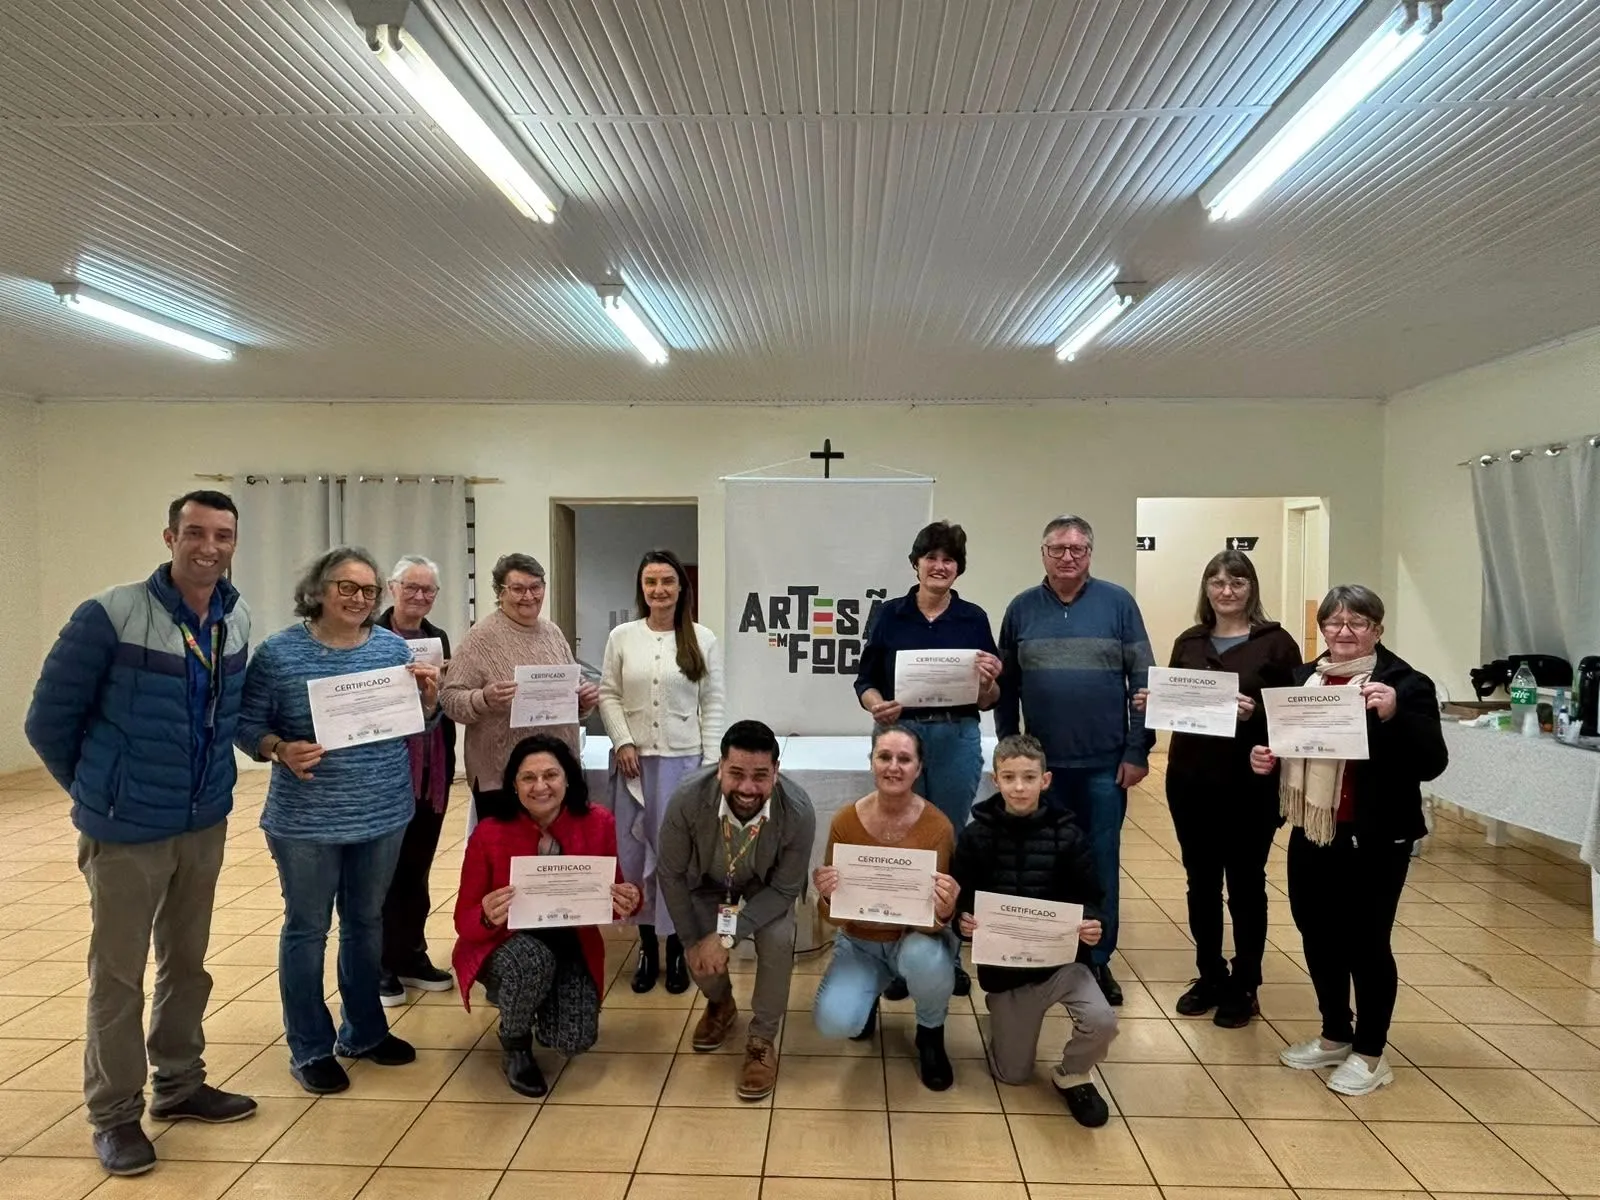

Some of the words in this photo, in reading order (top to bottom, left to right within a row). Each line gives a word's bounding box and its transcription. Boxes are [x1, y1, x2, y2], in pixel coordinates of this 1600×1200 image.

[738, 585, 887, 640] ARTESÃ
[788, 633, 862, 675] FOC
[915, 656, 961, 664] CERTIFICADO
[530, 672, 566, 680] CERTIFICADO
[1168, 676, 1217, 686] CERTIFICADO
[334, 677, 391, 693] CERTIFICADO
[1287, 695, 1341, 703] CERTIFICADO
[857, 855, 912, 866] CERTIFICADO
[536, 864, 592, 872] CERTIFICADO
[1000, 904, 1057, 918] CERTIFICADO
